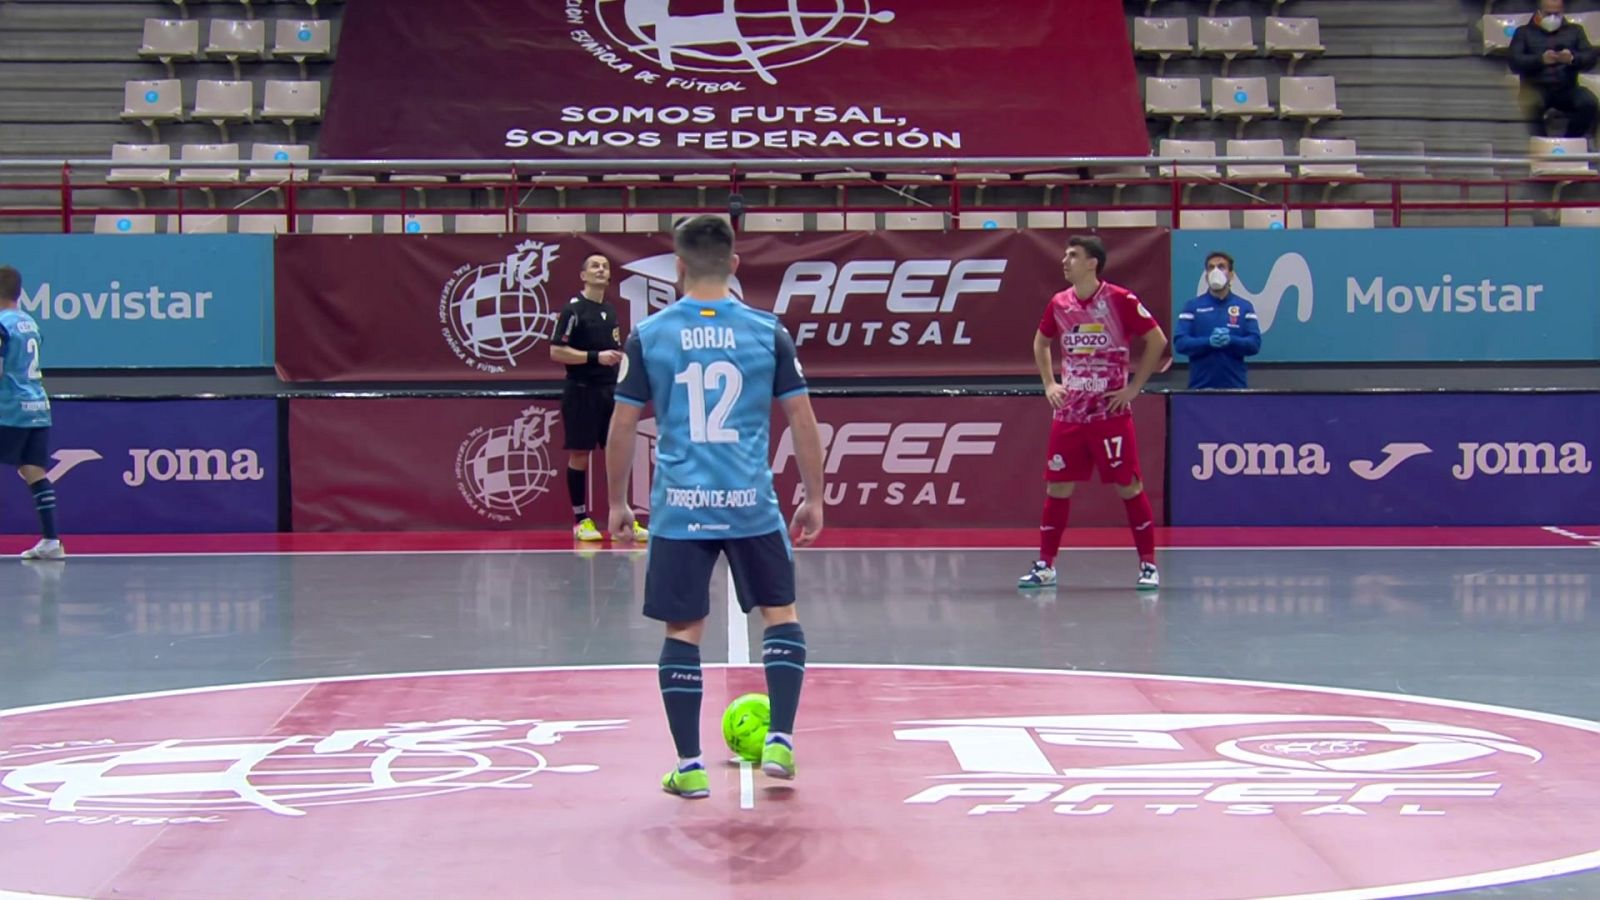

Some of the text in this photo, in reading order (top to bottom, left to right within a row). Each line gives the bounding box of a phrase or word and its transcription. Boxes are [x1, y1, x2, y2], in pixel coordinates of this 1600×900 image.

[634, 70, 661, 84] DE
[666, 77, 747, 93] FÚTBOL
[560, 106, 908, 126] SOMOS FUTSAL,
[504, 126, 962, 150] SOMOS FEDERACIÓN
[772, 259, 1008, 314] RFEF
[1346, 274, 1543, 314] Movistar
[17, 281, 213, 320] Movistar
[680, 326, 736, 350] BORJA
[797, 321, 972, 346] FUTSAL
[674, 360, 743, 444] 12
[1103, 436, 1123, 459] 17
[665, 484, 757, 510] TORREJÓN DE ARDOZ
[903, 782, 1502, 803] RFEF
[966, 804, 1447, 816] FUTSAL
